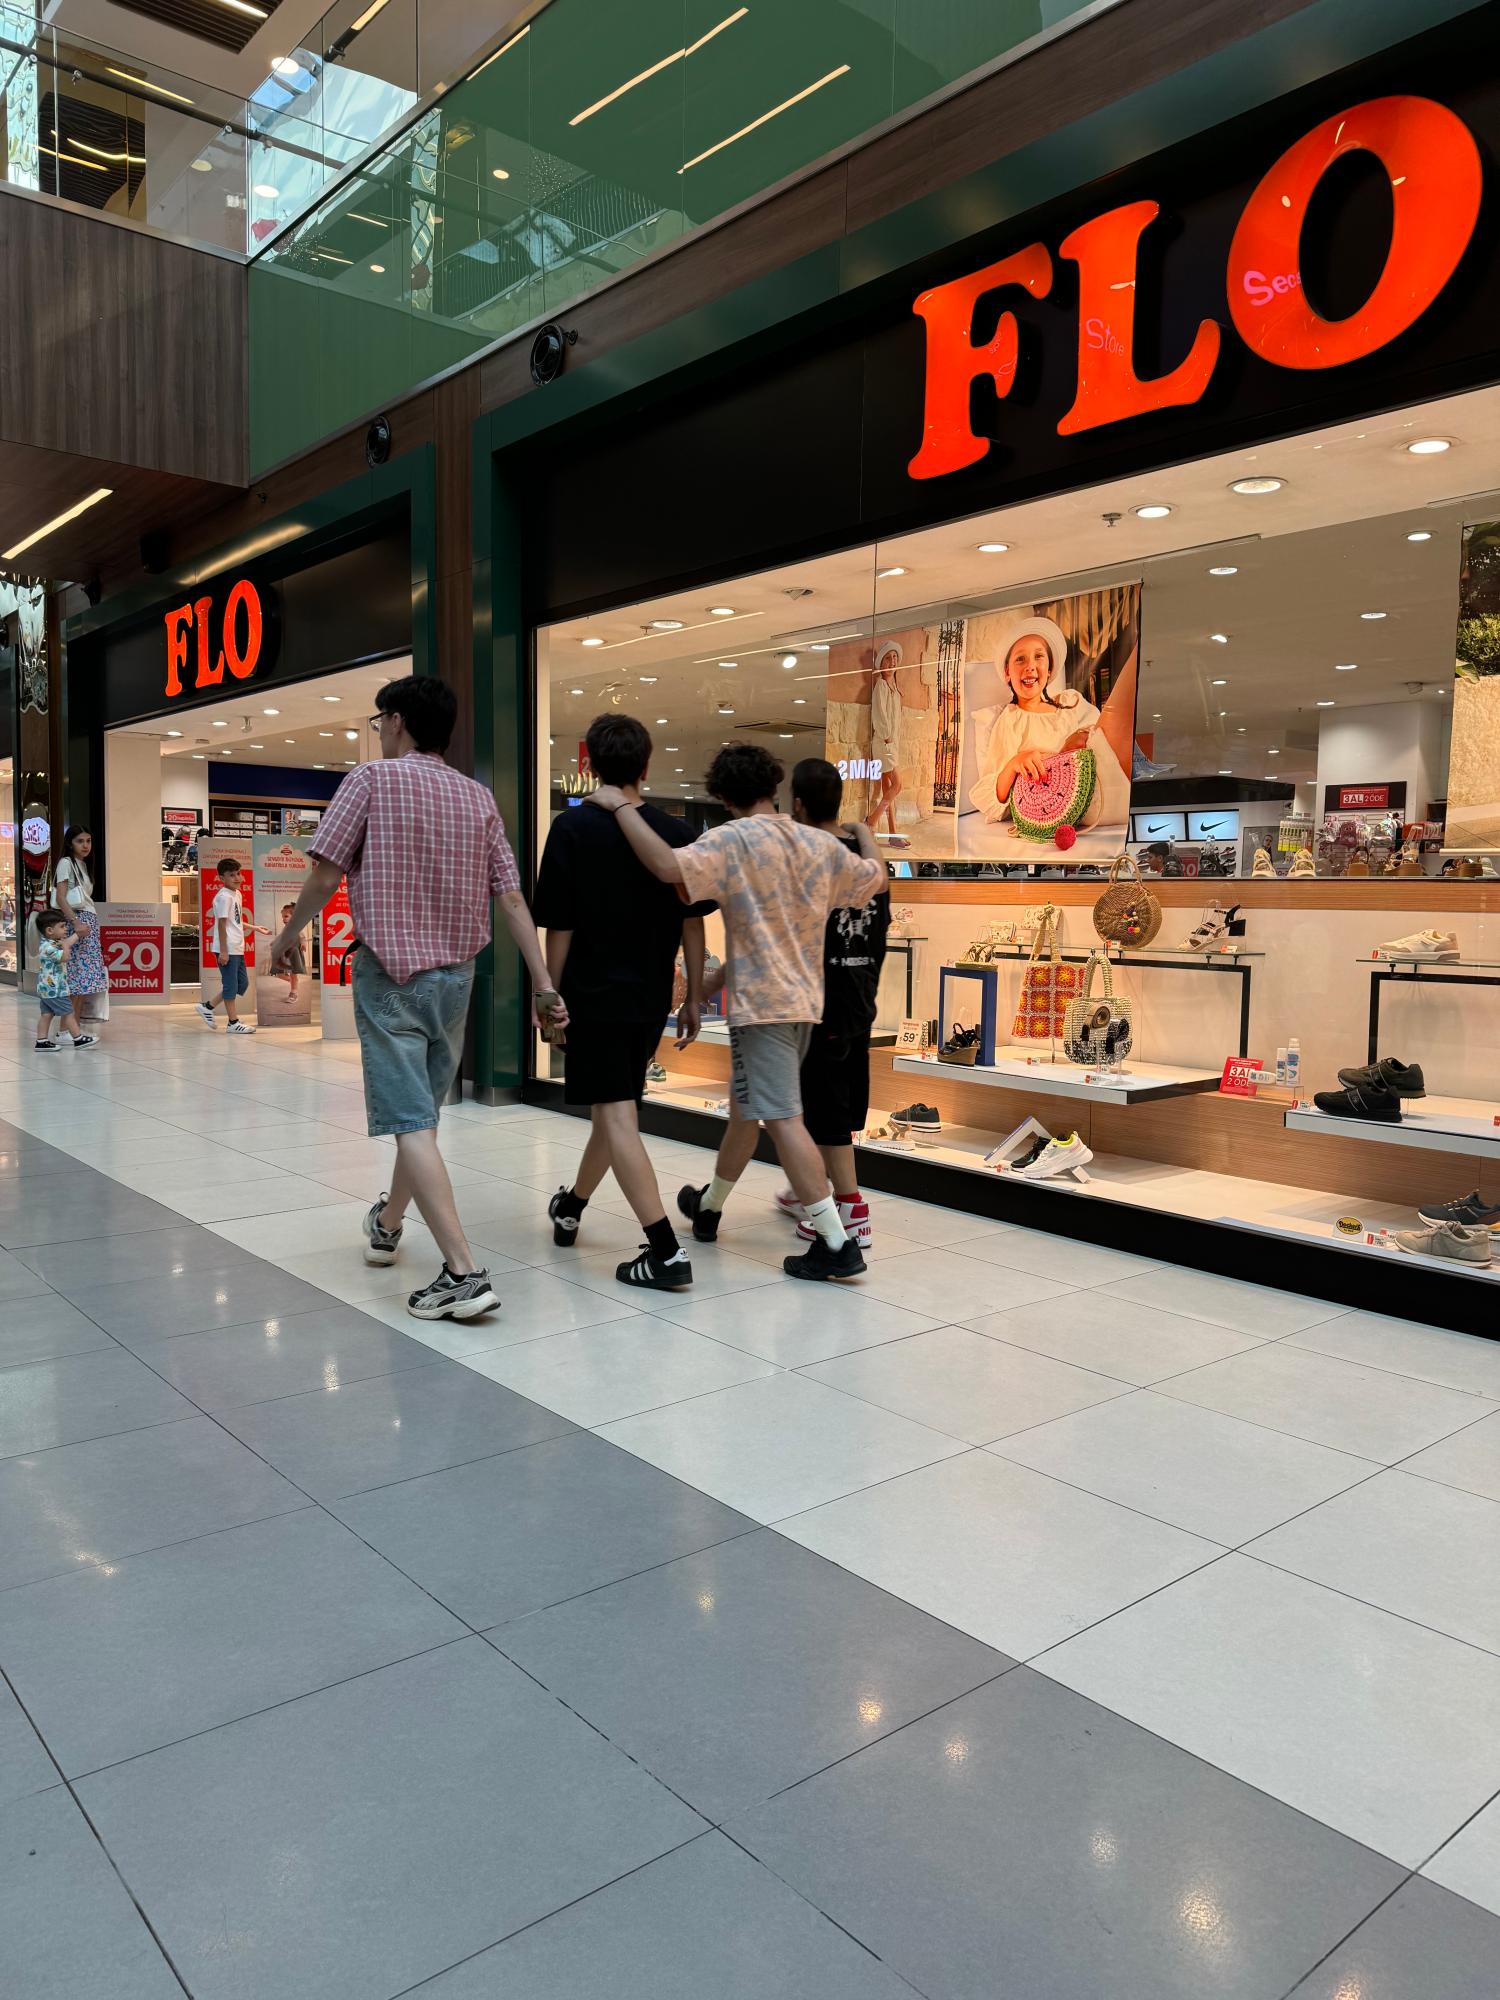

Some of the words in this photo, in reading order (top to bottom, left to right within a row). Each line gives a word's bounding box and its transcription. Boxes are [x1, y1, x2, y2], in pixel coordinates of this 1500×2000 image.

[908, 95, 1482, 479] FLO
[165, 580, 262, 696] FLO
[327, 912, 354, 948] 2
[107, 942, 160, 972] 20
[109, 975, 158, 988] NDİRİM
